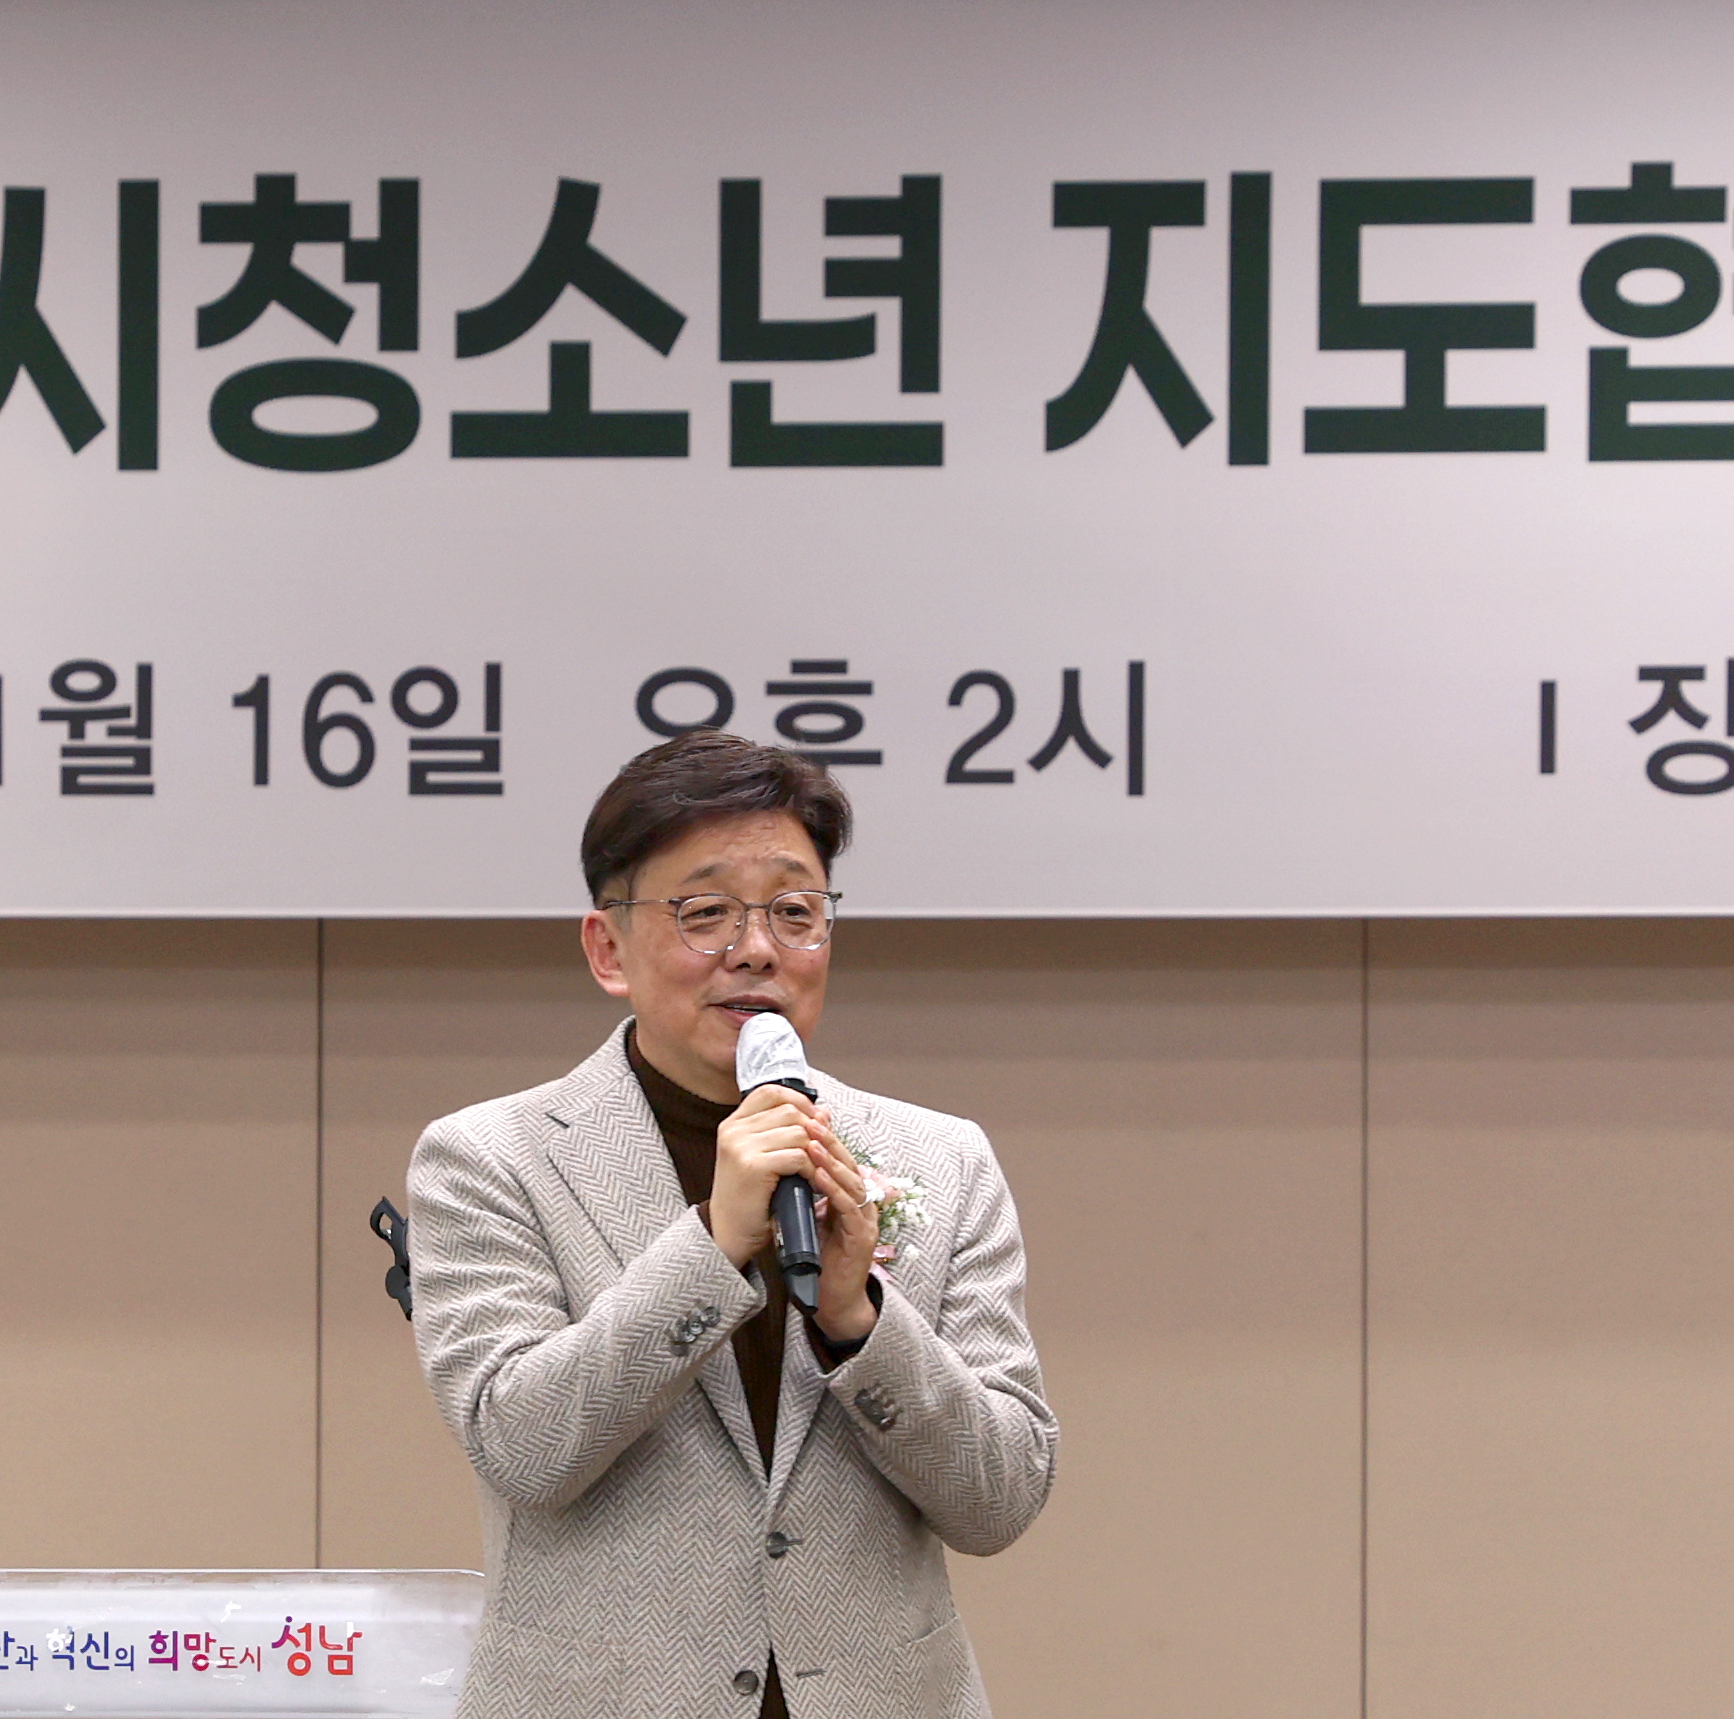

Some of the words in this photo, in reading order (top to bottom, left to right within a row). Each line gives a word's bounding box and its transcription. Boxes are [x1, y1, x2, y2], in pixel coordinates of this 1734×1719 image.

[231, 661, 505, 798] 16일
[944, 659, 1147, 797] 2시
[148, 1629, 262, 1673] 희망도시
[271, 1615, 364, 1677] 성남
